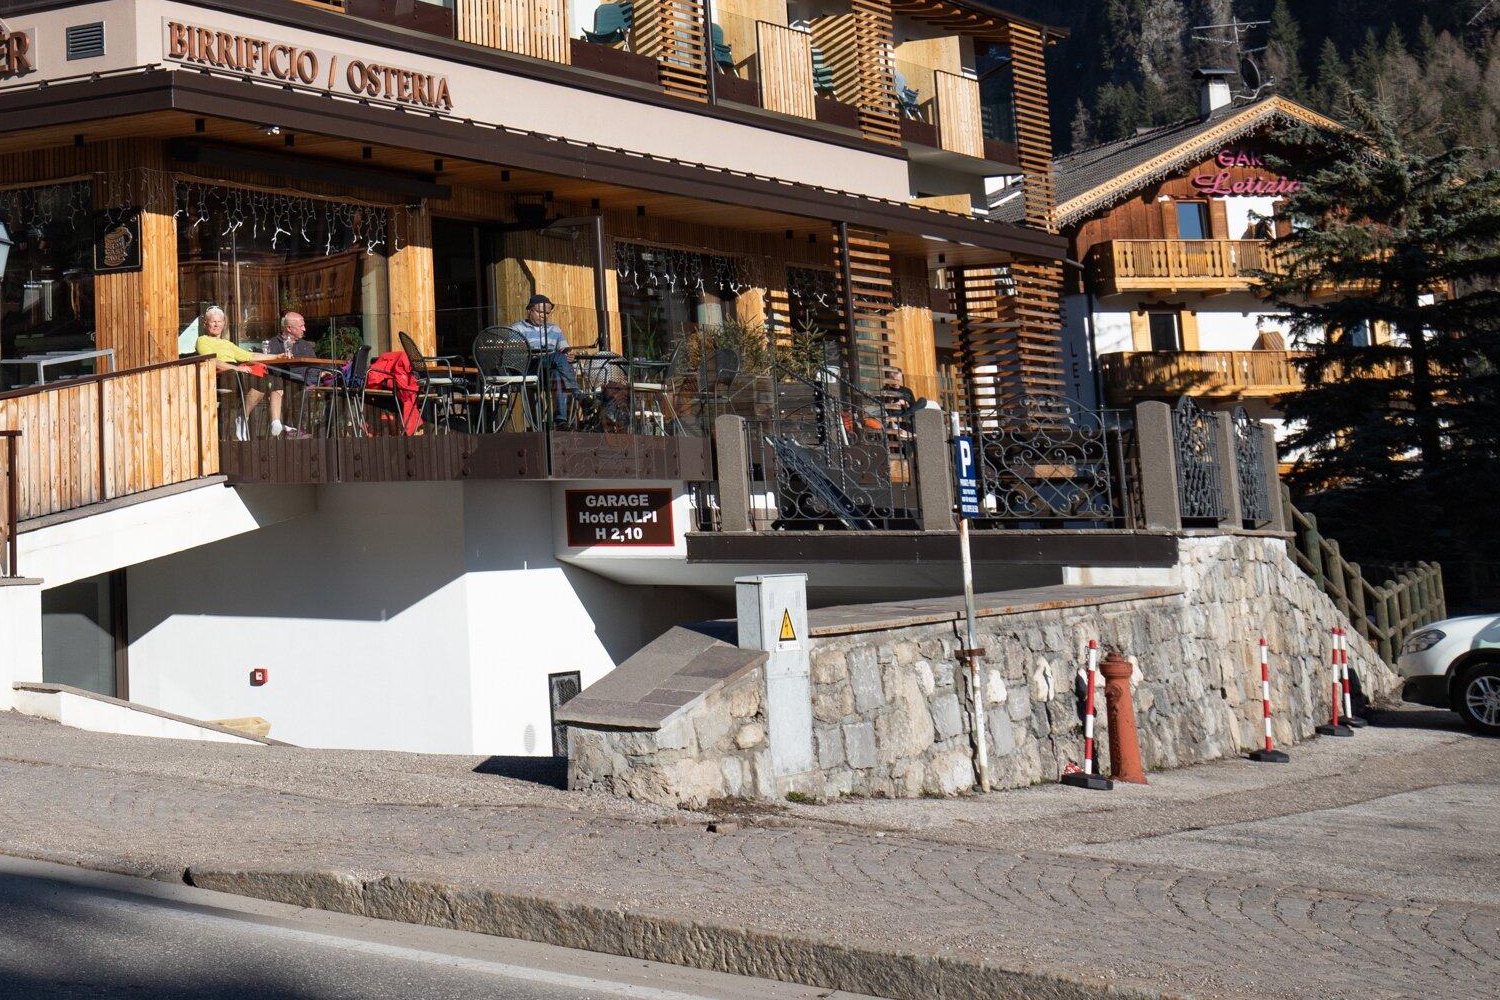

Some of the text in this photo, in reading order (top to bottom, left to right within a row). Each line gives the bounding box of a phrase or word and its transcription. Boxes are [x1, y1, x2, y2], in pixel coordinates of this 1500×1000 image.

[167, 21, 320, 85] BIRRIFICIO
[346, 59, 453, 111] OSTERIA
[960, 440, 972, 478] P
[585, 494, 649, 507] GARAGE
[579, 510, 658, 523] Hotel ALPI
[595, 527, 643, 542] H 2,10
